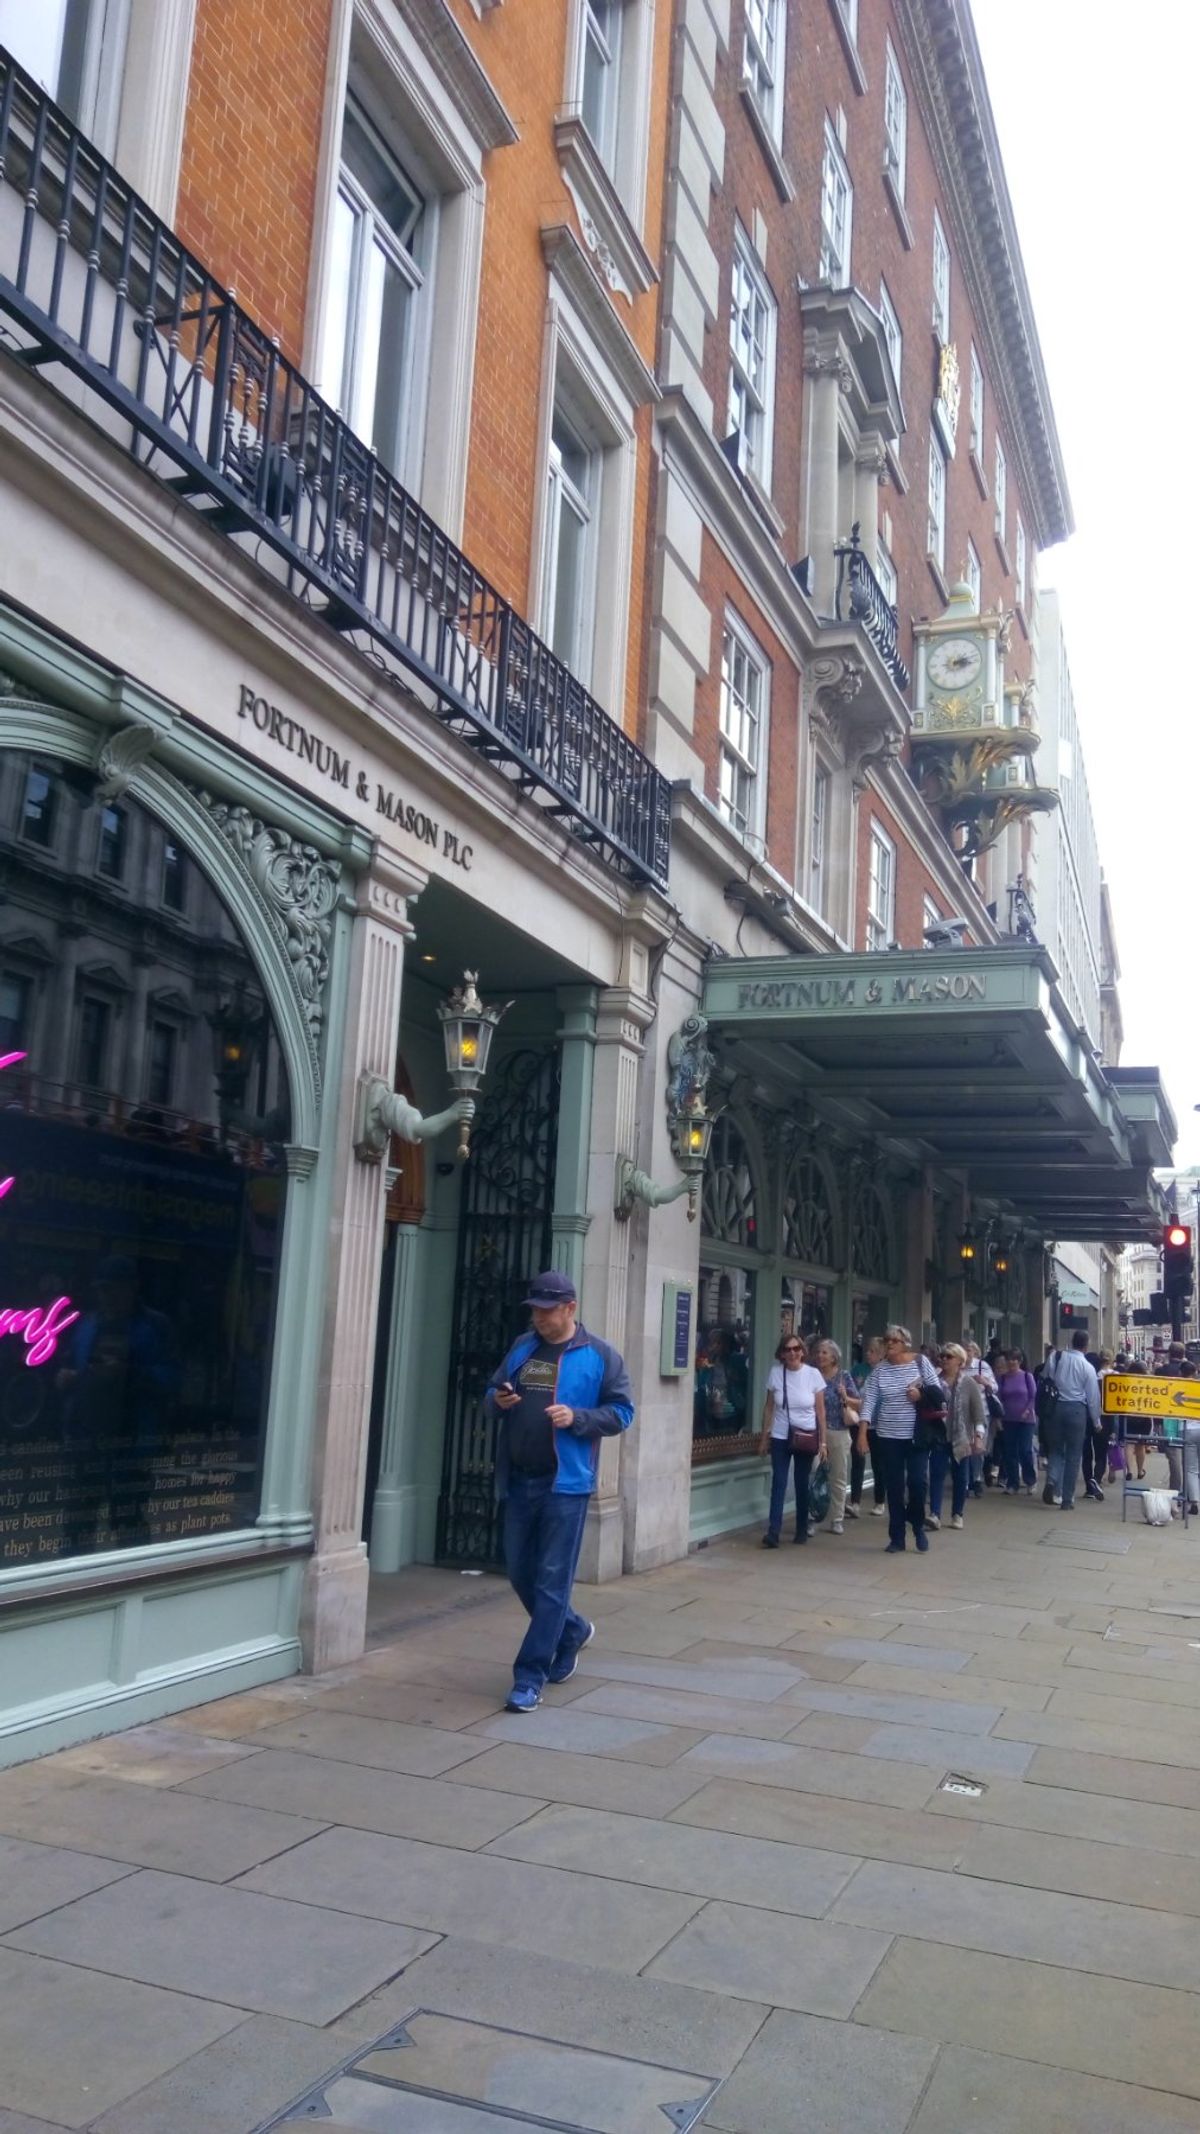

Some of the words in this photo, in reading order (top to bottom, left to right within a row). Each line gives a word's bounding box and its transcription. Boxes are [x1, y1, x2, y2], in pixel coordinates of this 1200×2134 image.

[237, 684, 351, 789] FORTNUM
[356, 771, 370, 803] &
[376, 784, 440, 849] MASON
[443, 830, 473, 871] PLC
[737, 979, 855, 1010] FORTNUM
[864, 979, 883, 1004] &
[893, 974, 988, 1004] MASON
[1108, 1382, 1169, 1396] Diverted
[1116, 1396, 1161, 1409] traffic
[0, 1467, 24, 1480] een
[28, 1489, 51, 1504] our
[0, 1518, 19, 1532] ave
[23, 1513, 52, 1529] been
[162, 1498, 182, 1511] our
[4, 1538, 33, 1558] they
[165, 1521, 178, 1533] as
[181, 1514, 207, 1534] plant
